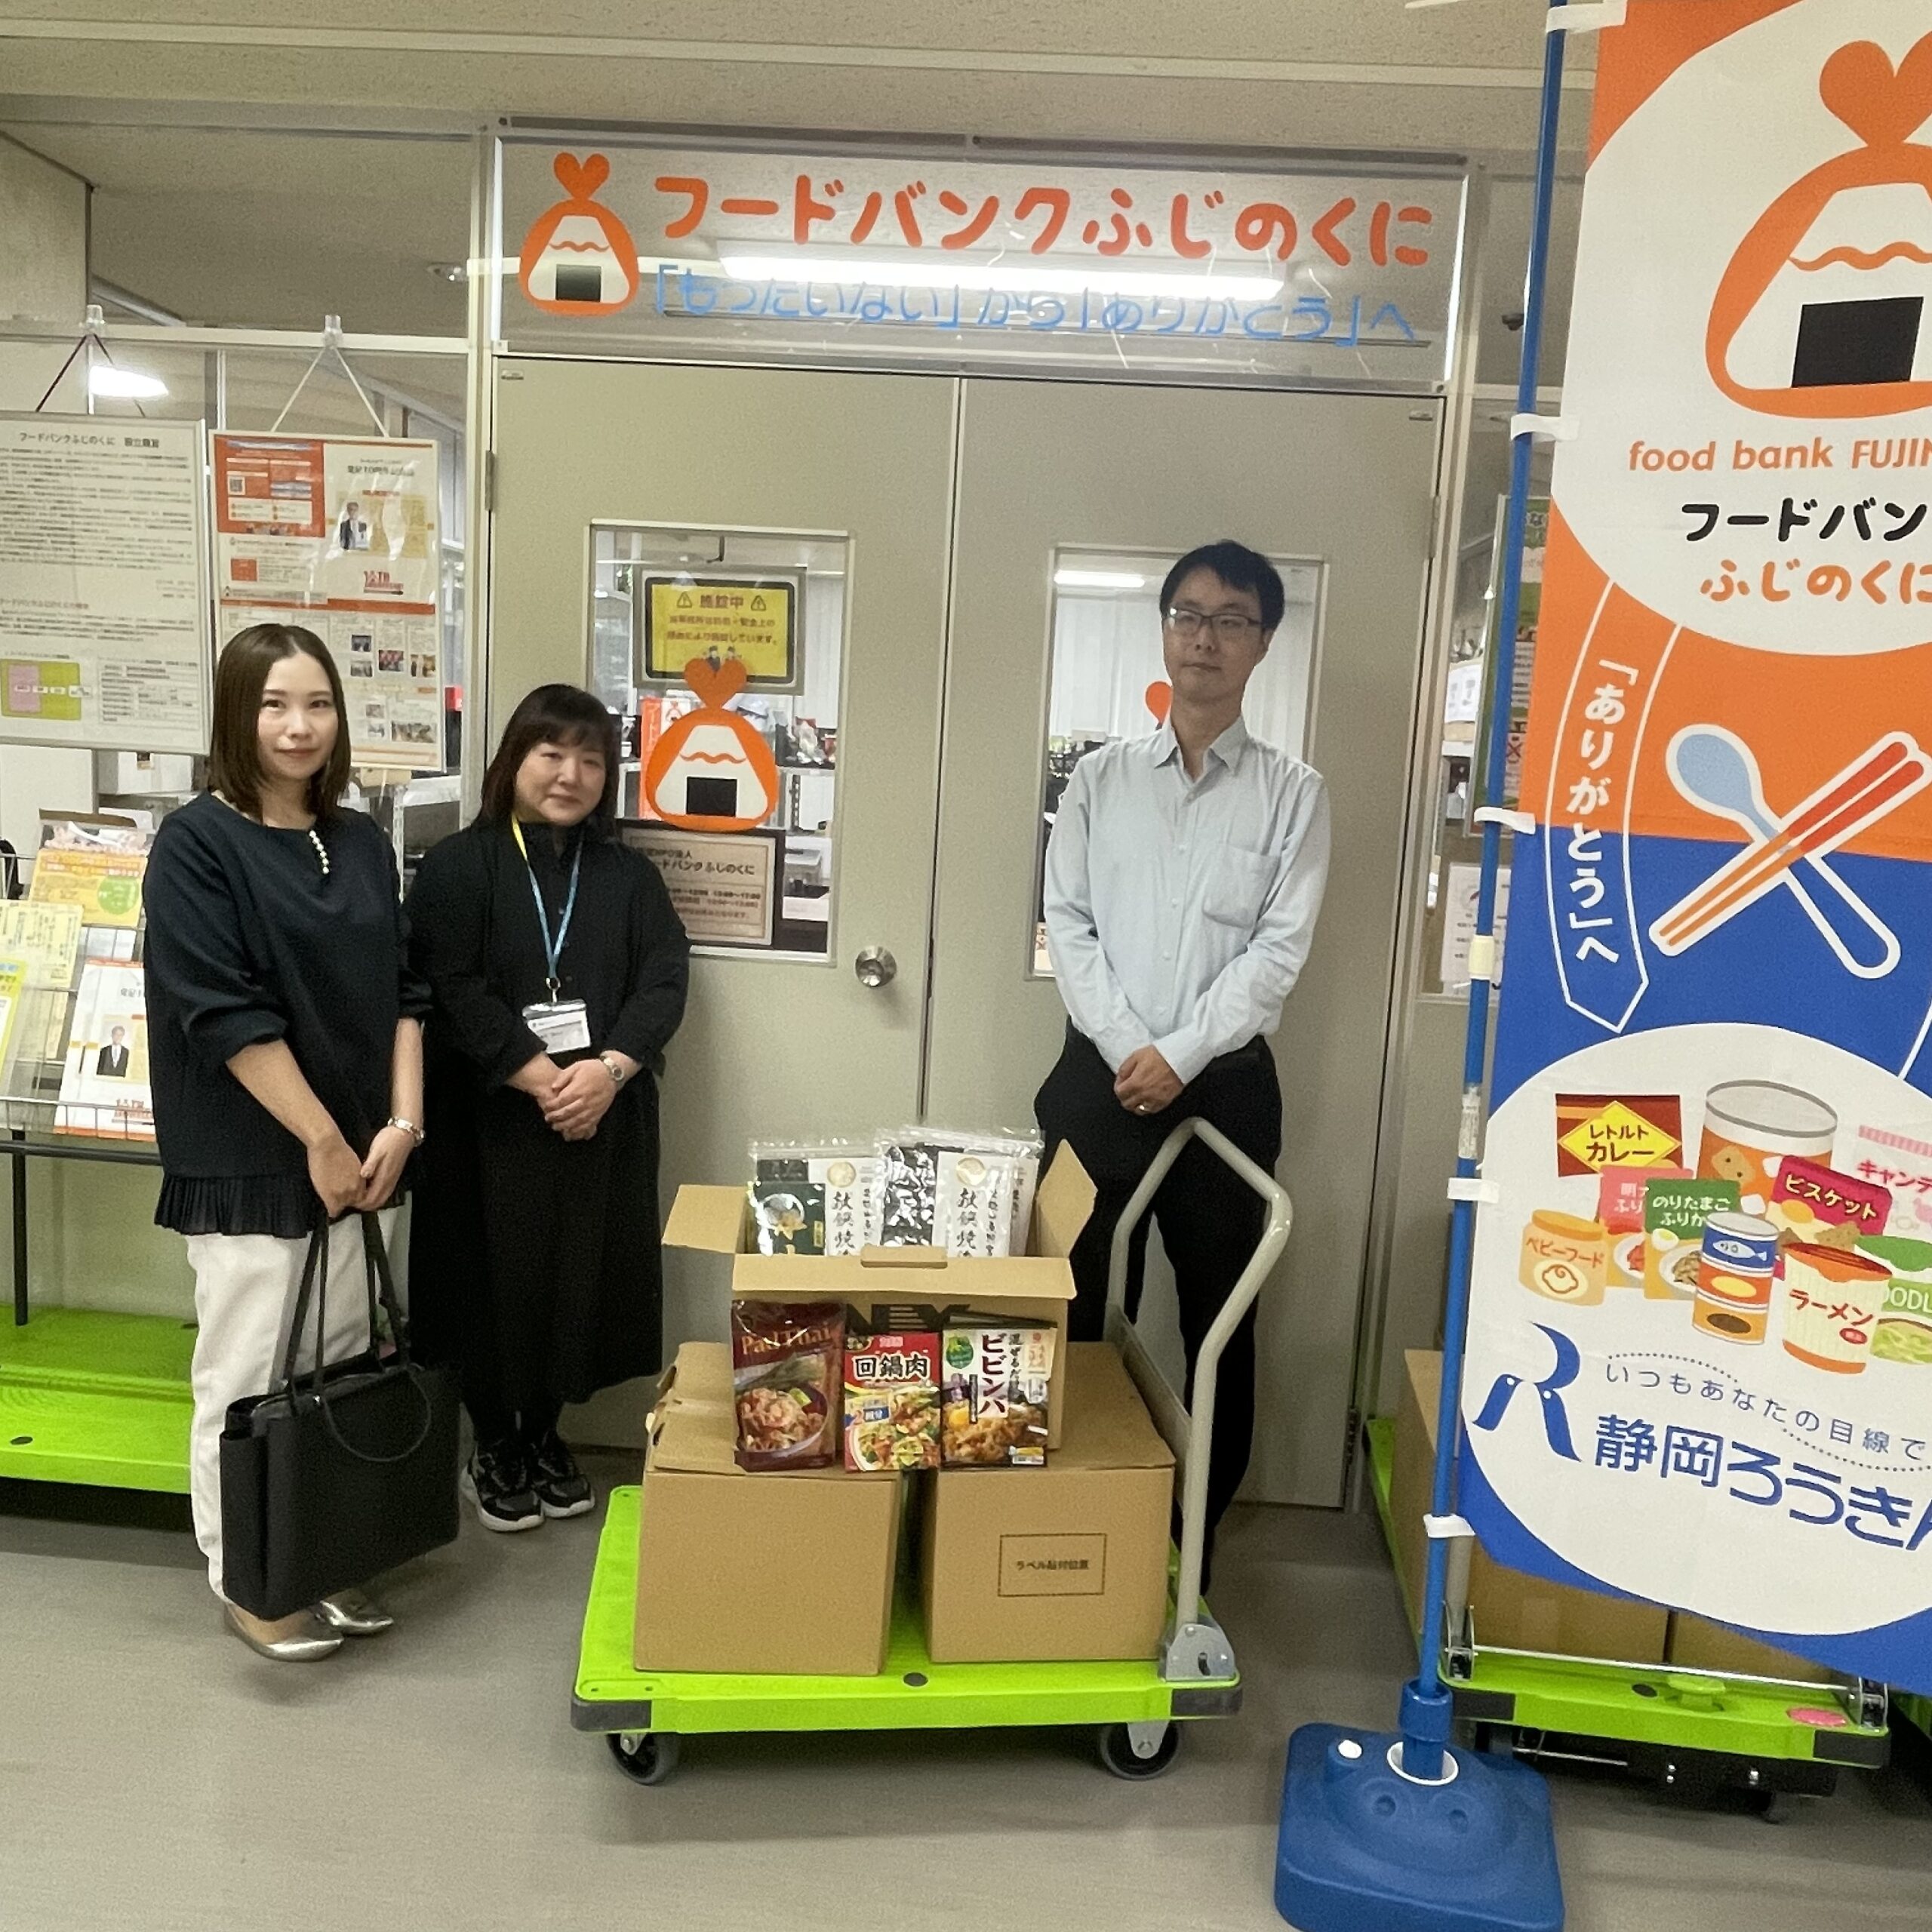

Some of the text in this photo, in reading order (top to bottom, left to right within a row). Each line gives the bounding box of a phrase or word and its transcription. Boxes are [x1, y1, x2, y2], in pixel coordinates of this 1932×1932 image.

[654, 174, 1432, 267] フードバンクふじのくに
[1629, 441, 1717, 470] food
[1733, 437, 1833, 469] bank
[1682, 497, 1927, 542] フードバン
[1700, 558, 1932, 604] ふじのくに
[1566, 659, 1640, 964] 「ありがとう」へ
[1586, 1141, 1655, 1162] カレー
[1589, 1124, 1649, 1141] レトルト
[1786, 1174, 1876, 1220] ビスケット
[1789, 1288, 1873, 1326] ラーメン
[854, 1353, 928, 1378] 回鍋肉
[979, 1333, 1008, 1414] ビビンバ
[1606, 1363, 1925, 1460] いつもあなたの目線で
